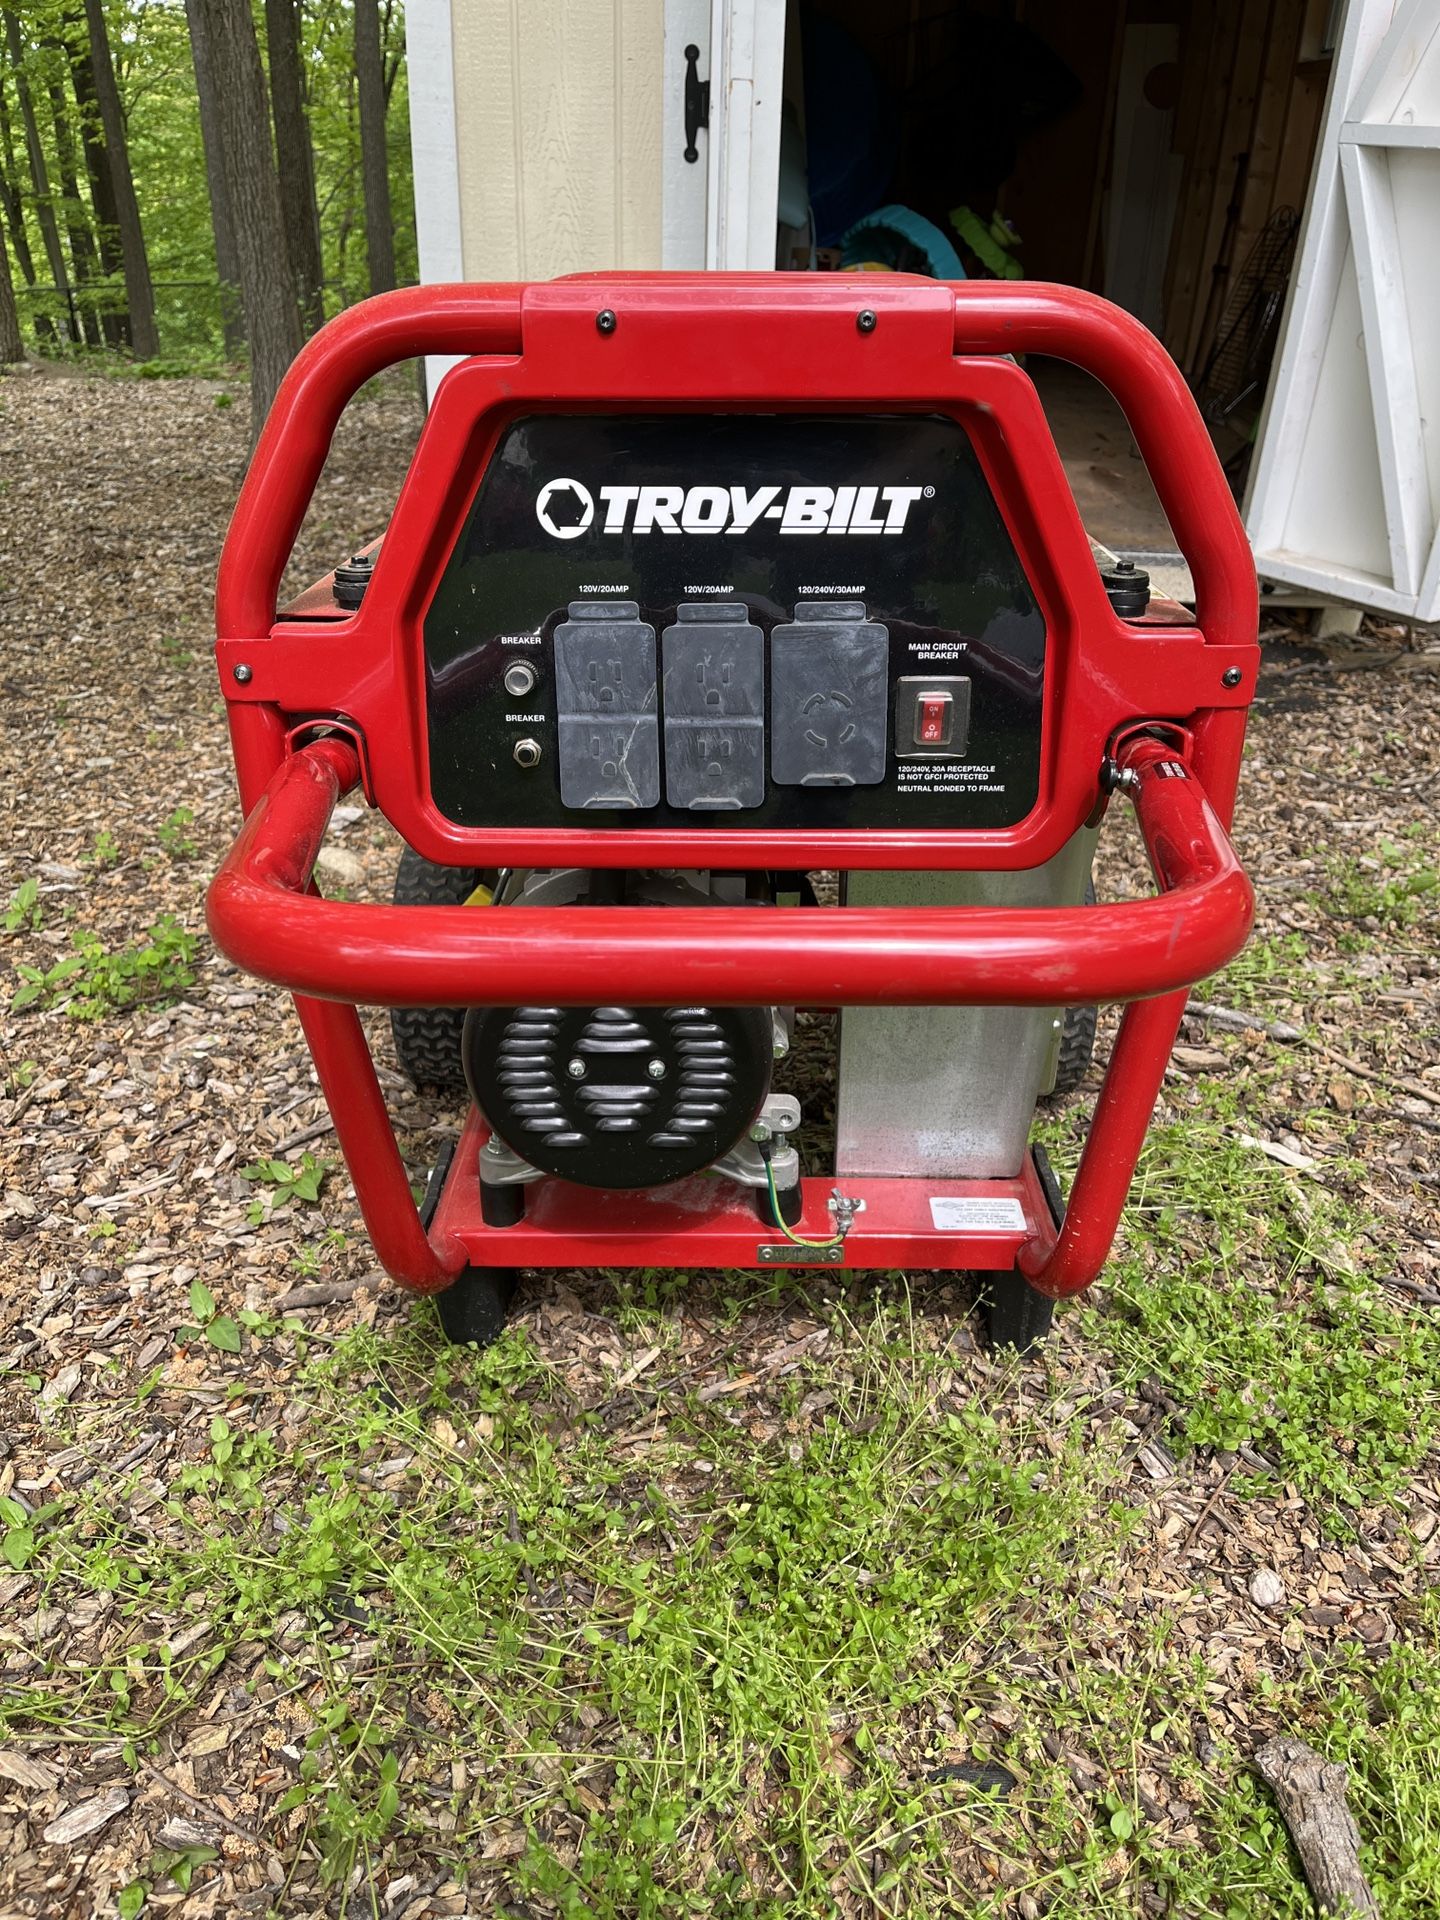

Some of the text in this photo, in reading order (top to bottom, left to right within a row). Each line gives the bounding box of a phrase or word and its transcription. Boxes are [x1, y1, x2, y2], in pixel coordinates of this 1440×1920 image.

[578, 585, 629, 593] 120V/20AMP
[797, 585, 866, 593] 120/240V/30AMP
[501, 636, 542, 644] BREAKER
[908, 643, 968, 651] MAIN CIRCUIT
[505, 714, 545, 722] BREAKER
[898, 765, 931, 773] 120/240V,
[947, 765, 996, 773] RECEPTACLE
